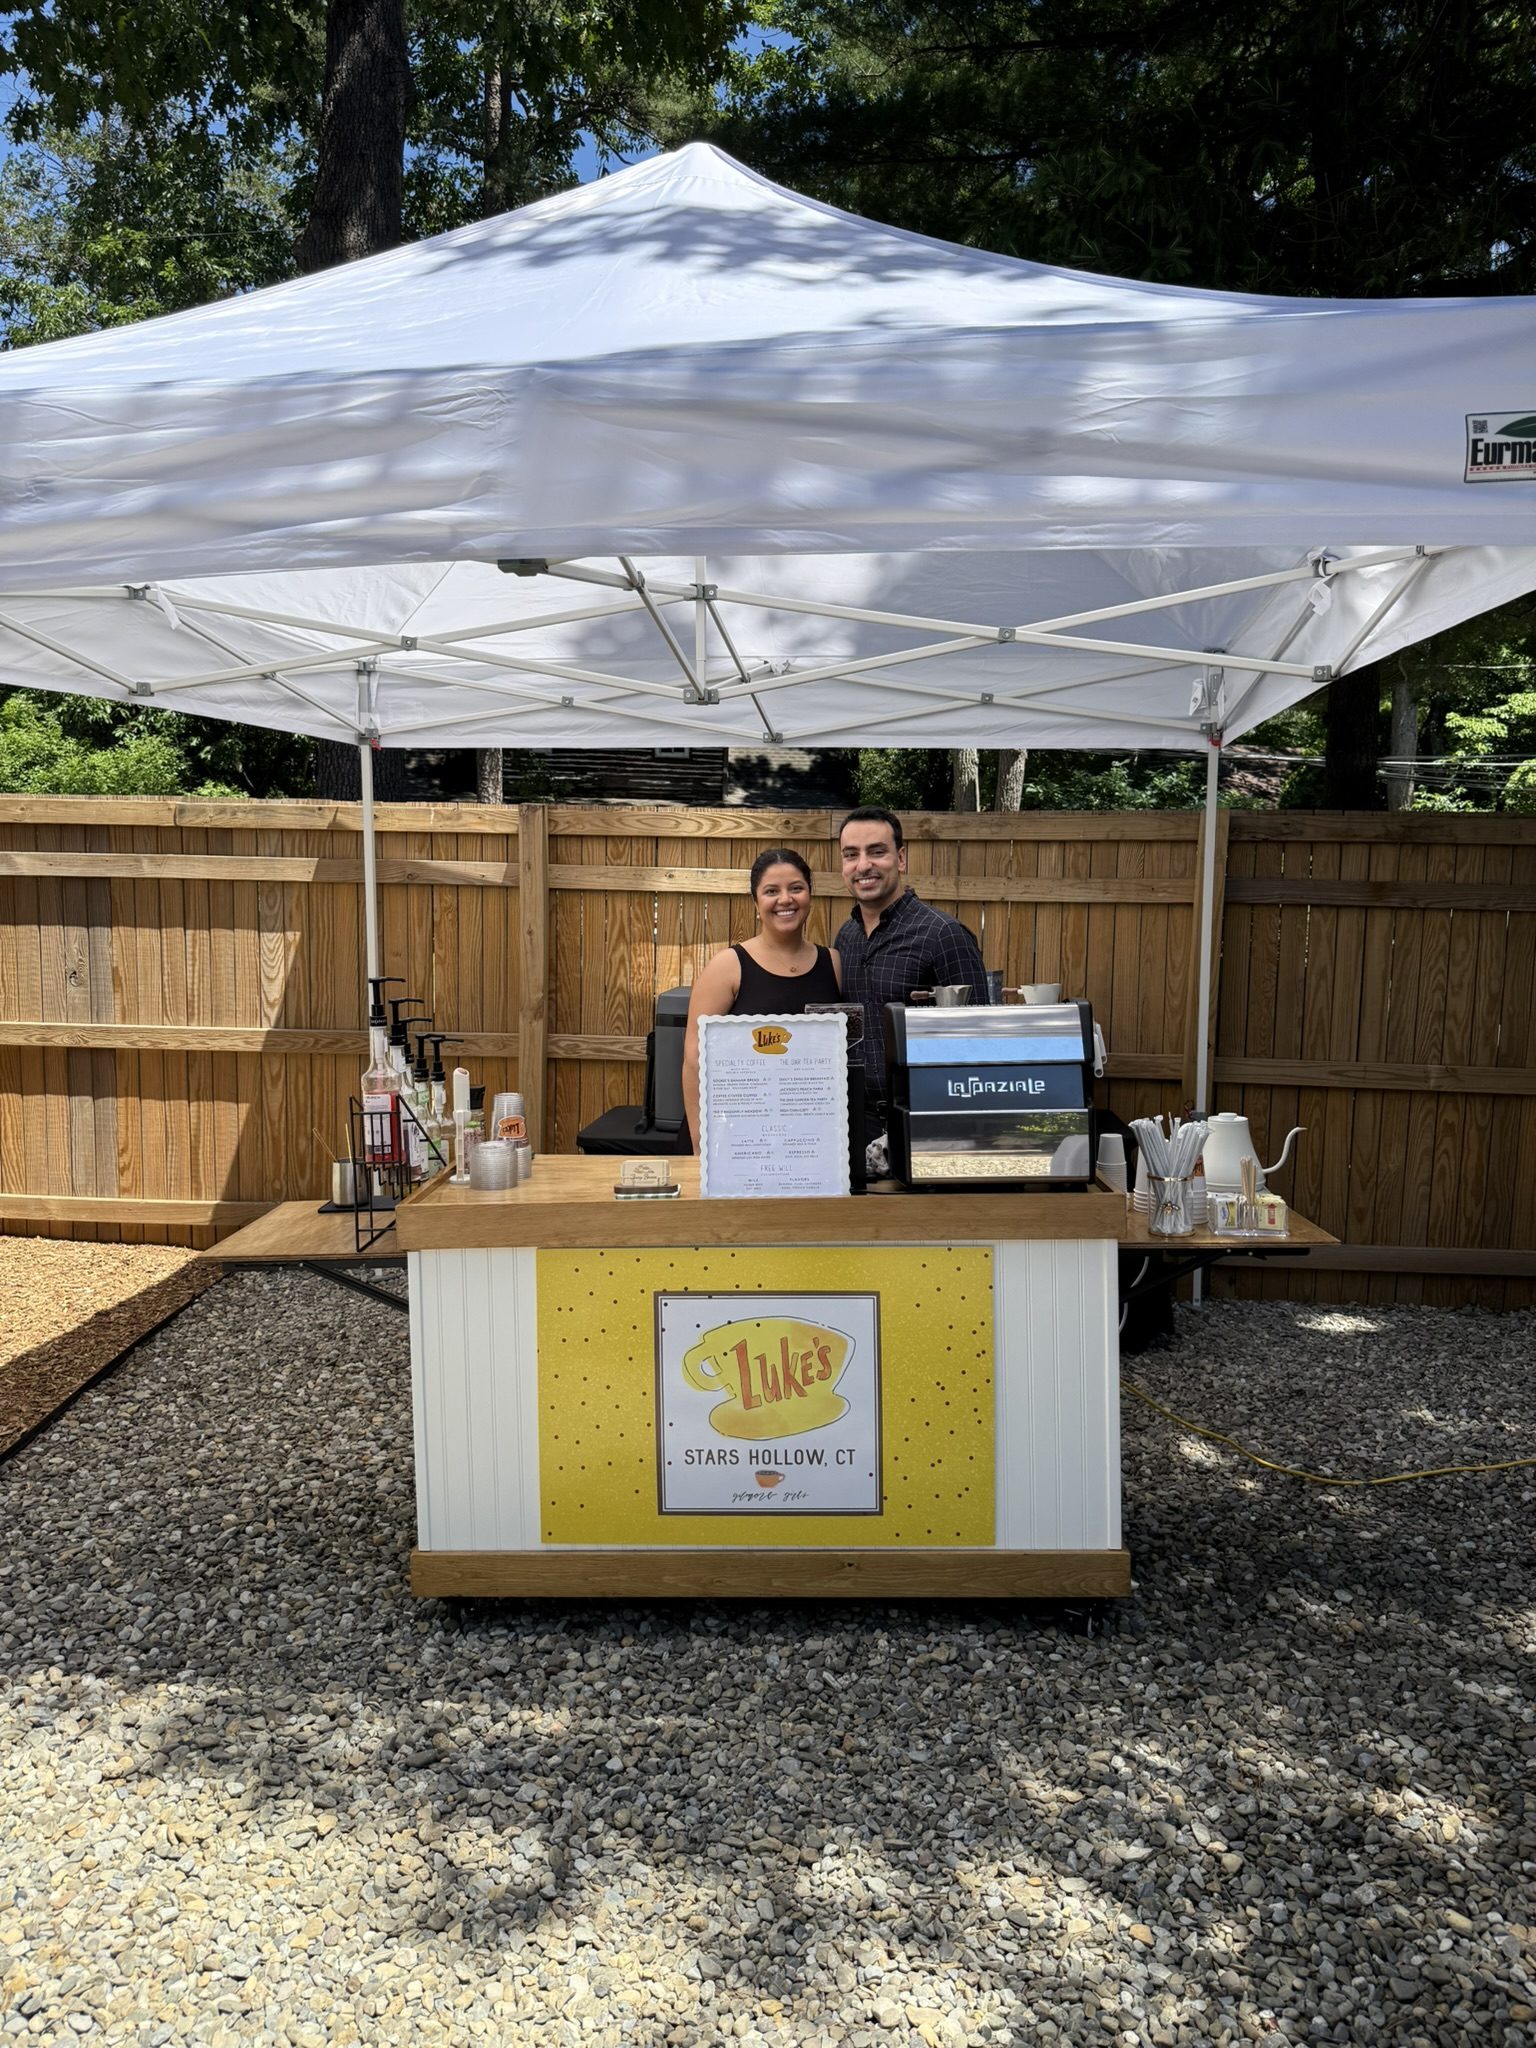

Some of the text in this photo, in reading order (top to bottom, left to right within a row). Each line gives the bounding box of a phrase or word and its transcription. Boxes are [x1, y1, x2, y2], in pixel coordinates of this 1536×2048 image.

[684, 1449, 856, 1467] STARS HOLLOW, CT
